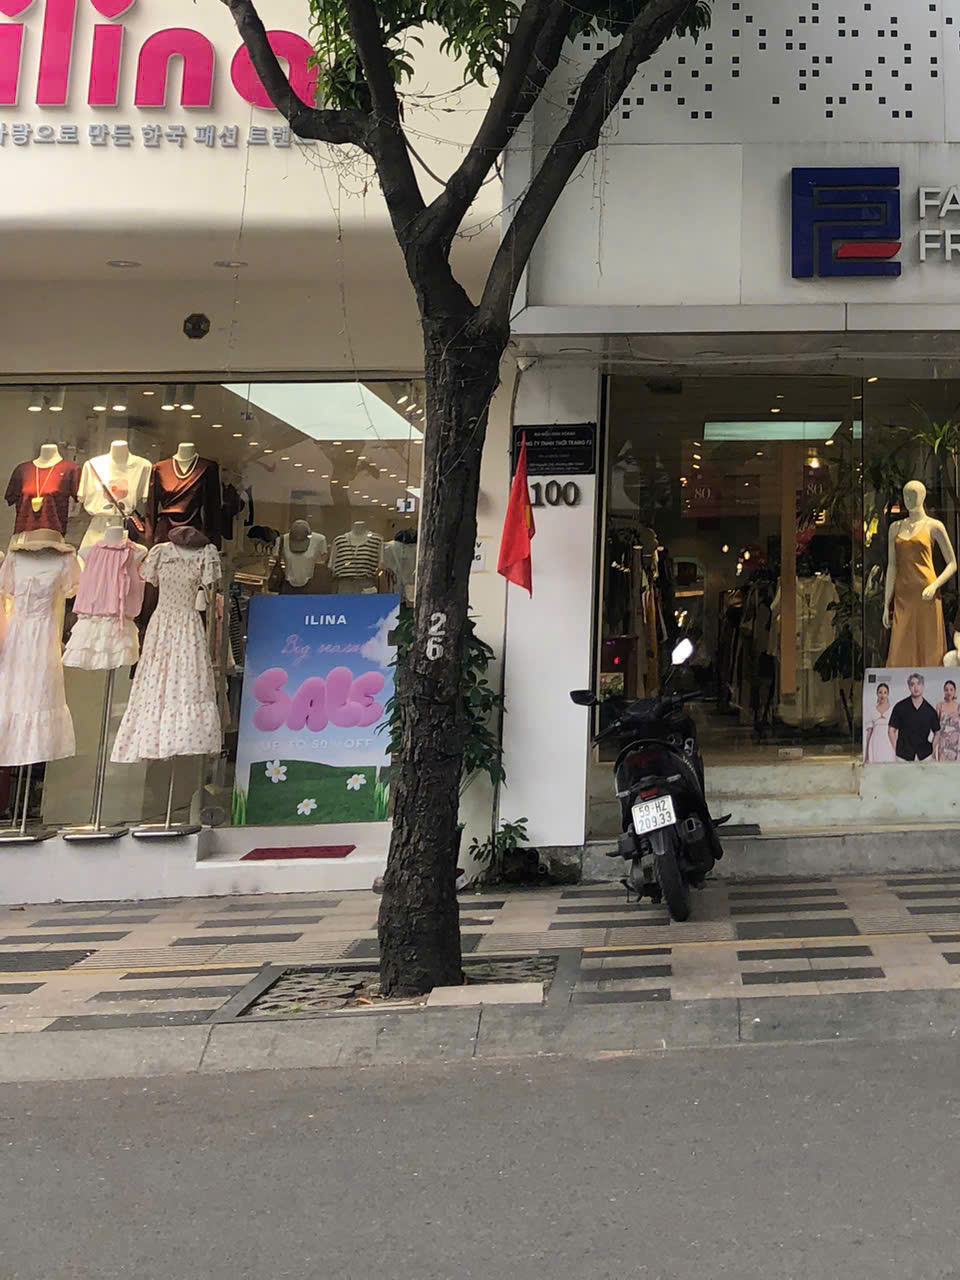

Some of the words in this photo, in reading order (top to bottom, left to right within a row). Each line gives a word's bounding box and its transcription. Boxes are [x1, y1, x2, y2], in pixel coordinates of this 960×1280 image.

[88, 123, 133, 146] 만든
[142, 124, 186, 148] 한국
[193, 124, 238, 148] 패션
[247, 125, 317, 148] 트렌
[530, 480, 581, 507] 100
[304, 614, 347, 626] ILINA
[253, 666, 386, 733] SALE
[344, 738, 374, 750] OFF
